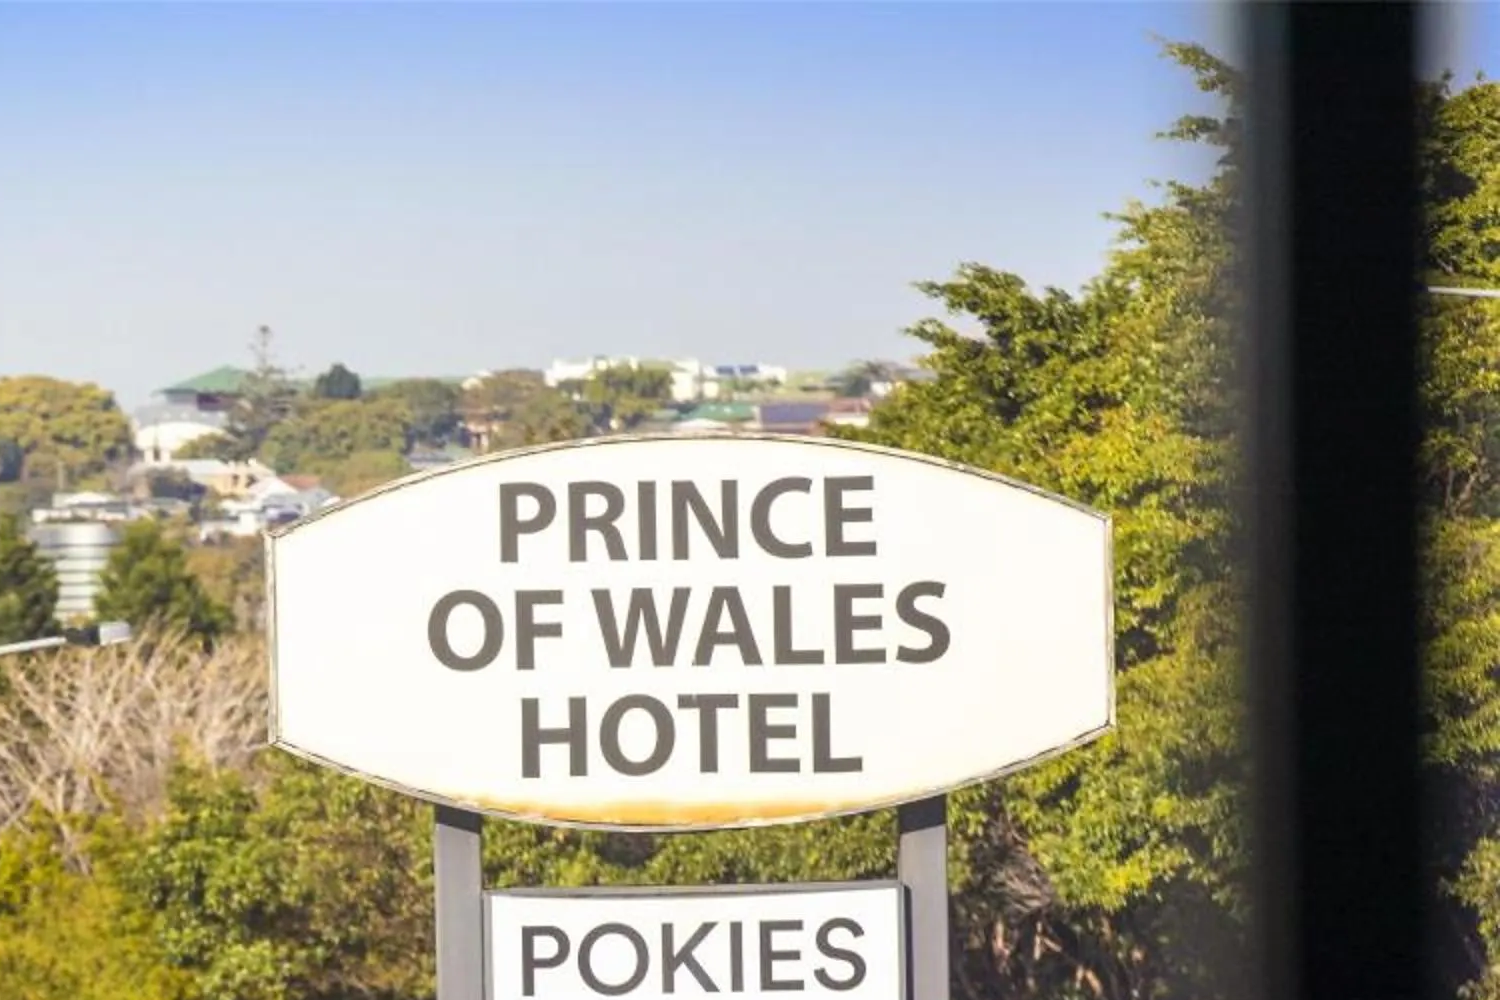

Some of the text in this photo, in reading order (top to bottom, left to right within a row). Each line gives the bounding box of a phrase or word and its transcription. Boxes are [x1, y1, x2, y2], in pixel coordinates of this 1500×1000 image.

[500, 476, 877, 563] PRINCE
[427, 581, 952, 672] OF WALES
[520, 693, 863, 779] HOTEL
[521, 917, 868, 997] POKIES
